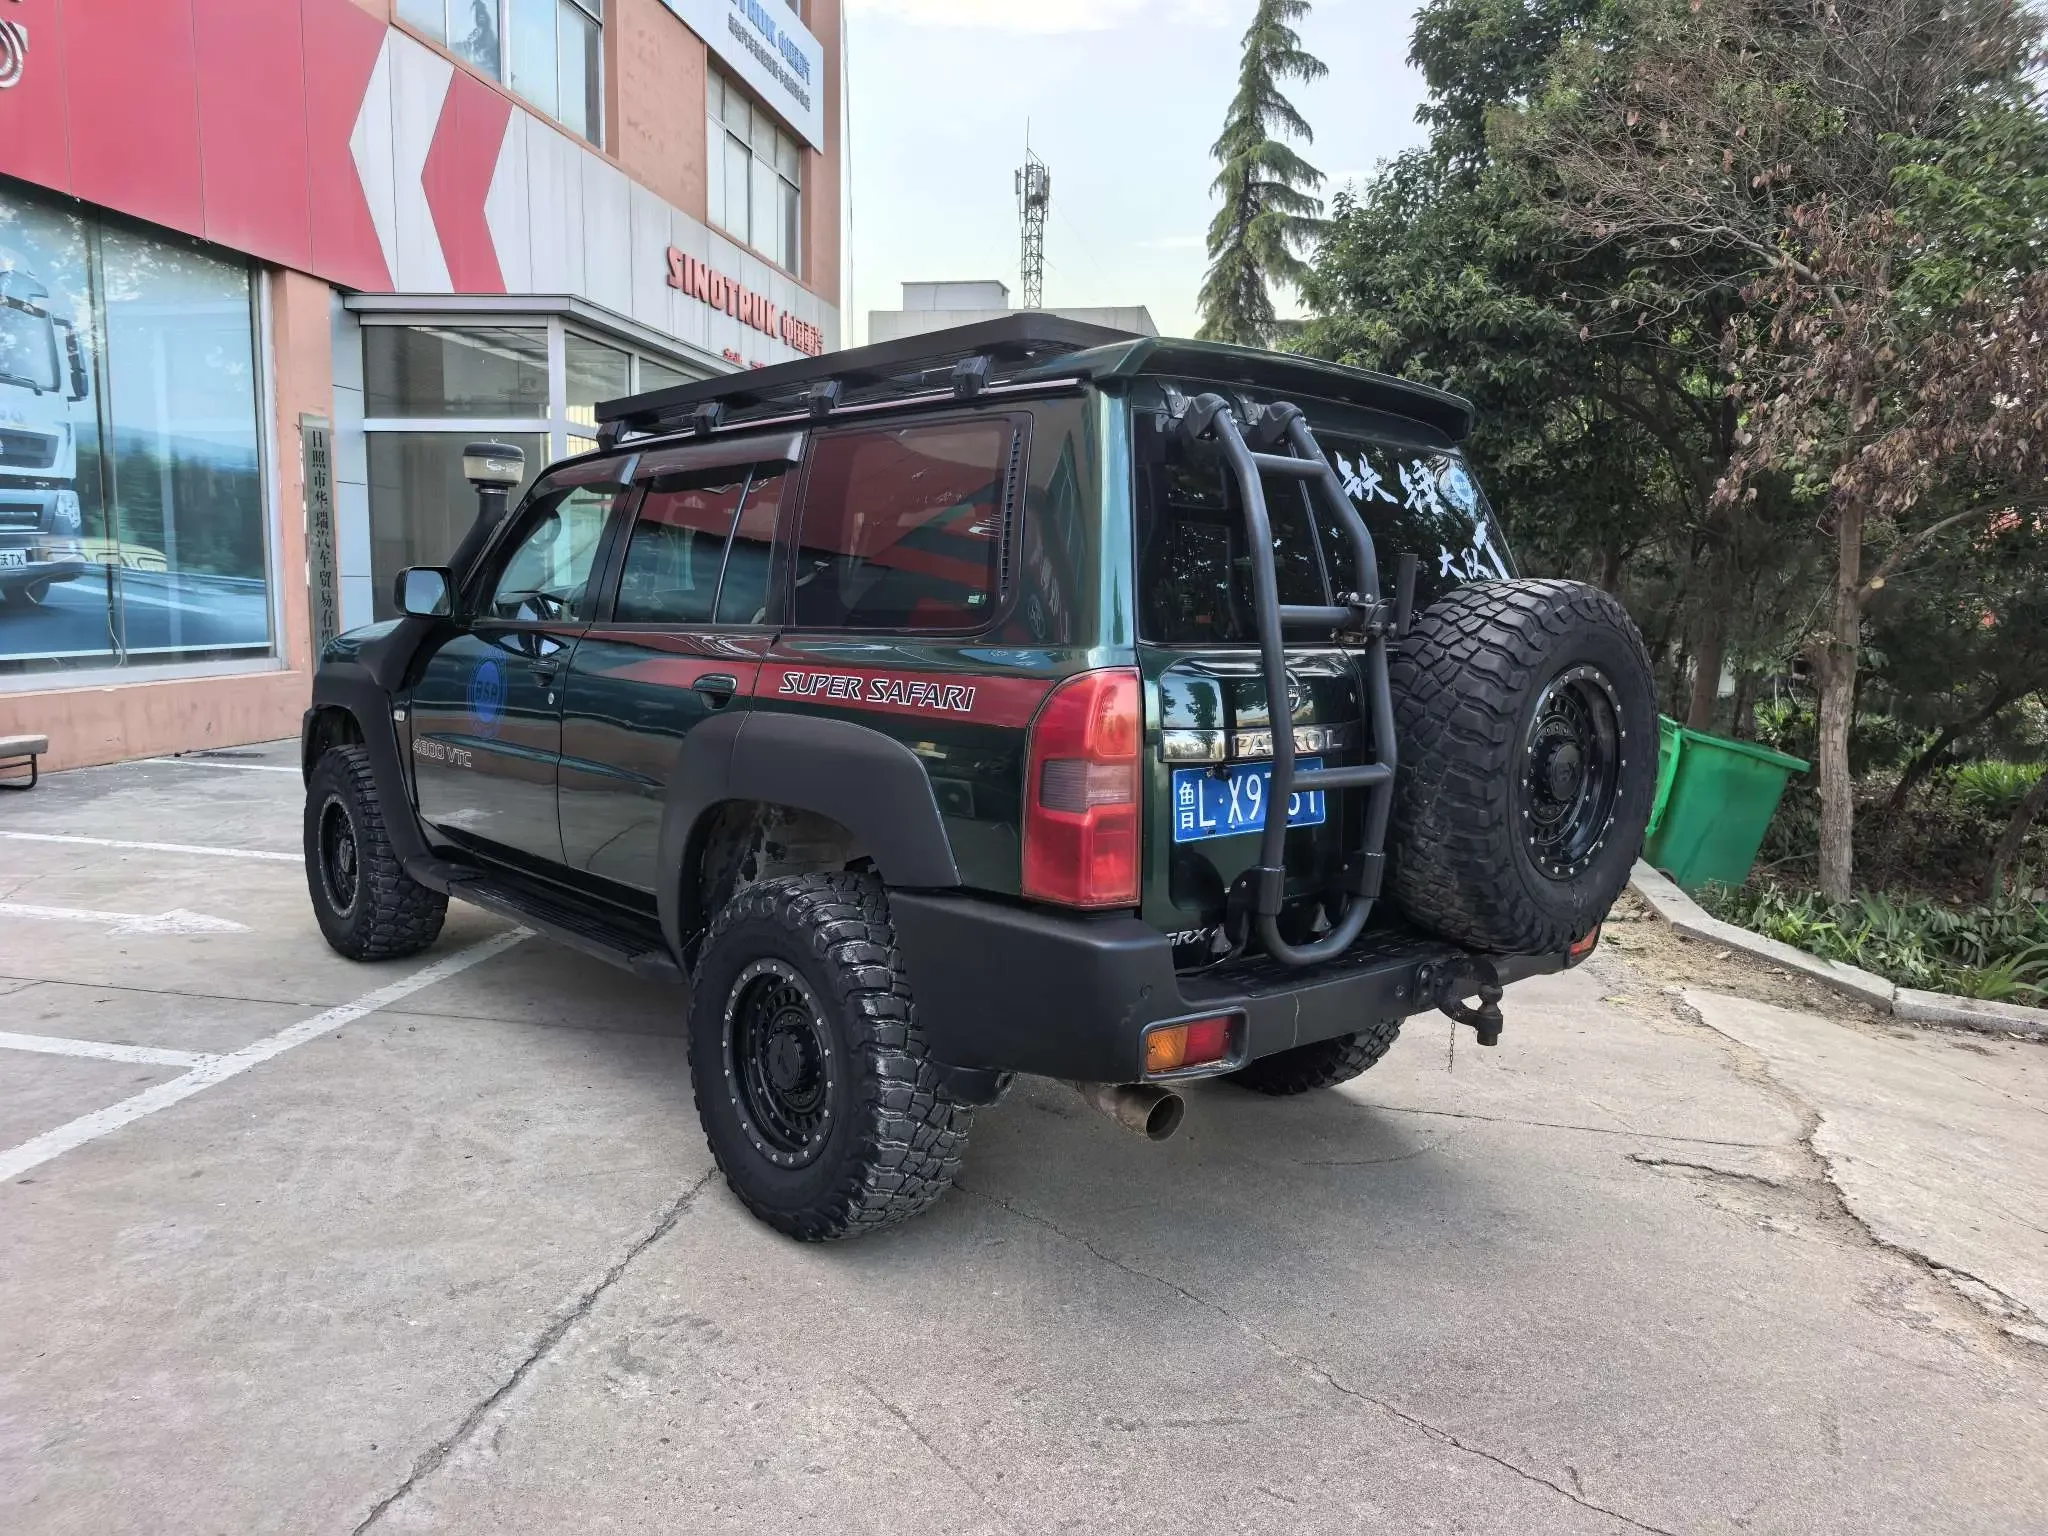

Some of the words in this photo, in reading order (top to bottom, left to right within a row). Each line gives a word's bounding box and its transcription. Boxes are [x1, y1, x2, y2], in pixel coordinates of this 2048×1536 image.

[667, 246, 779, 339] SINOTRUK
[779, 671, 863, 700] SUPER
[866, 679, 976, 713] SAFARI
[412, 738, 445, 760] 4800
[446, 747, 473, 768] VTC
[1231, 729, 1343, 757] PAROL
